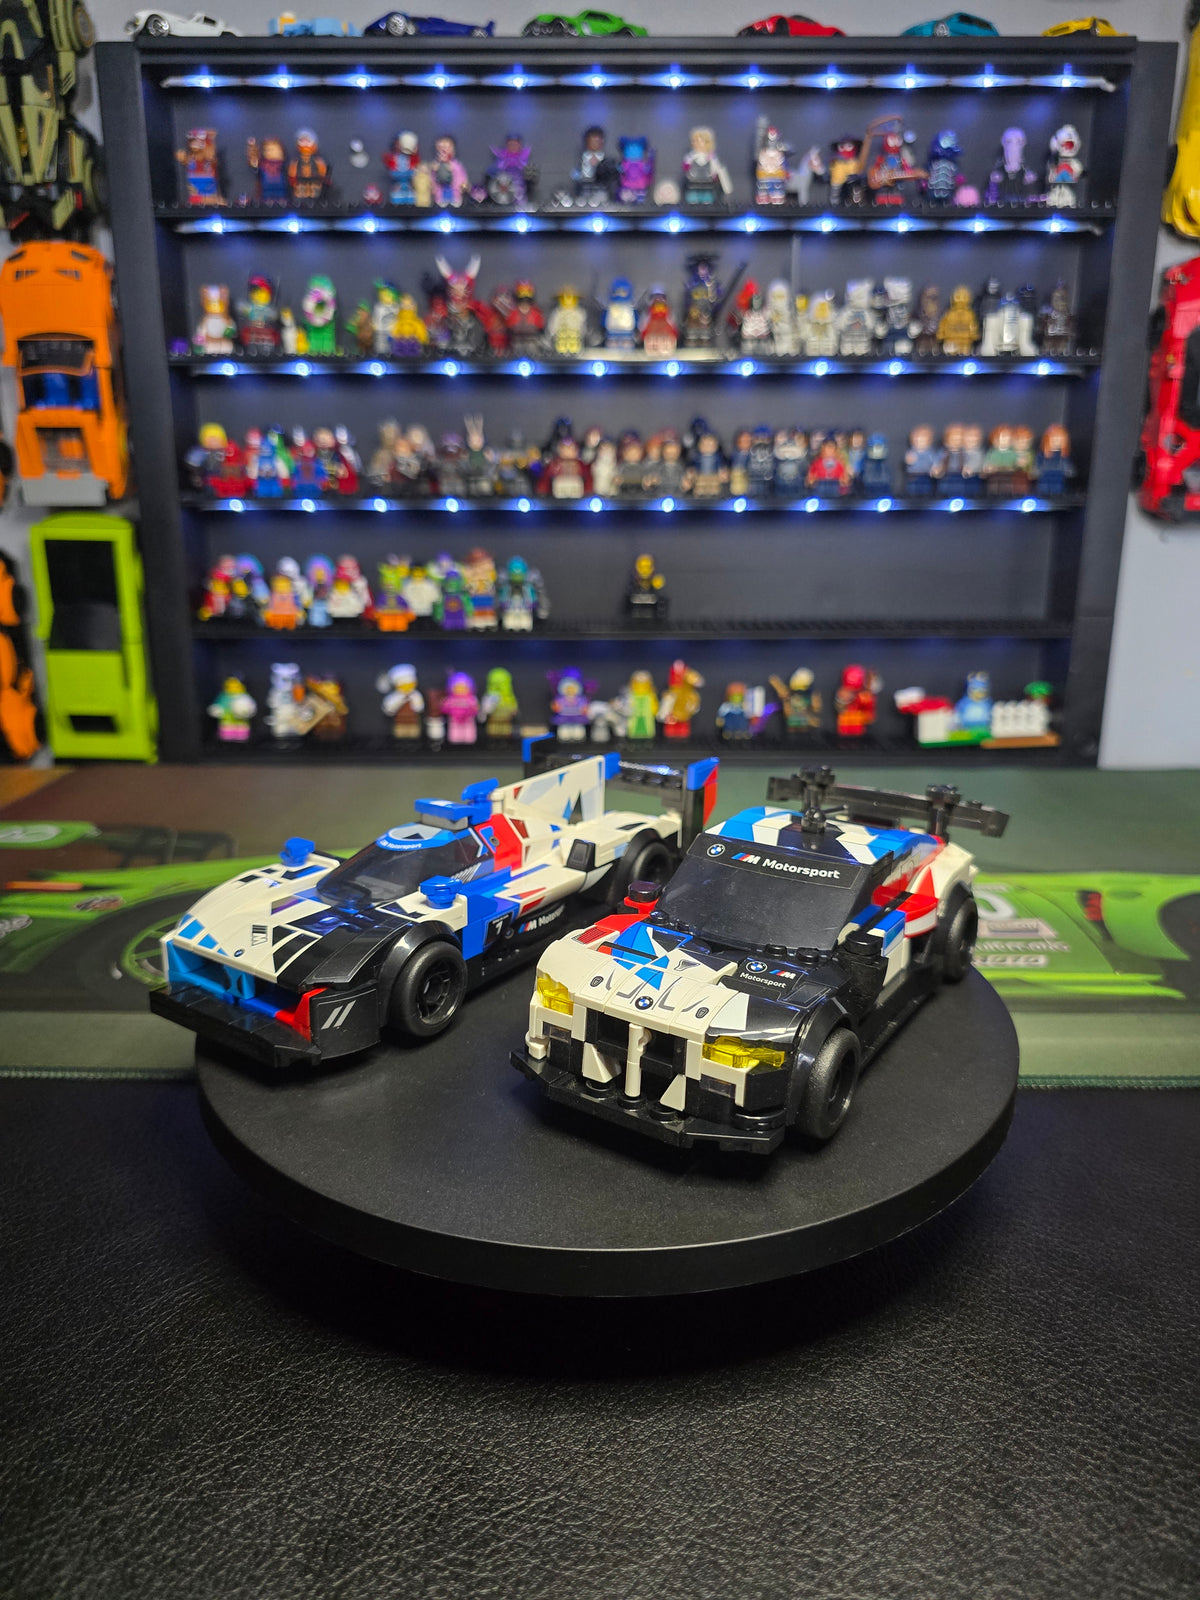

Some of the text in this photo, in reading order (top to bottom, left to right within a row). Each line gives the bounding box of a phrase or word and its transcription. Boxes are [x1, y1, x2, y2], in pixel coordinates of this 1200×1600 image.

[741, 855, 841, 879] M Motorsport
[740, 972, 787, 989] Motorsport
